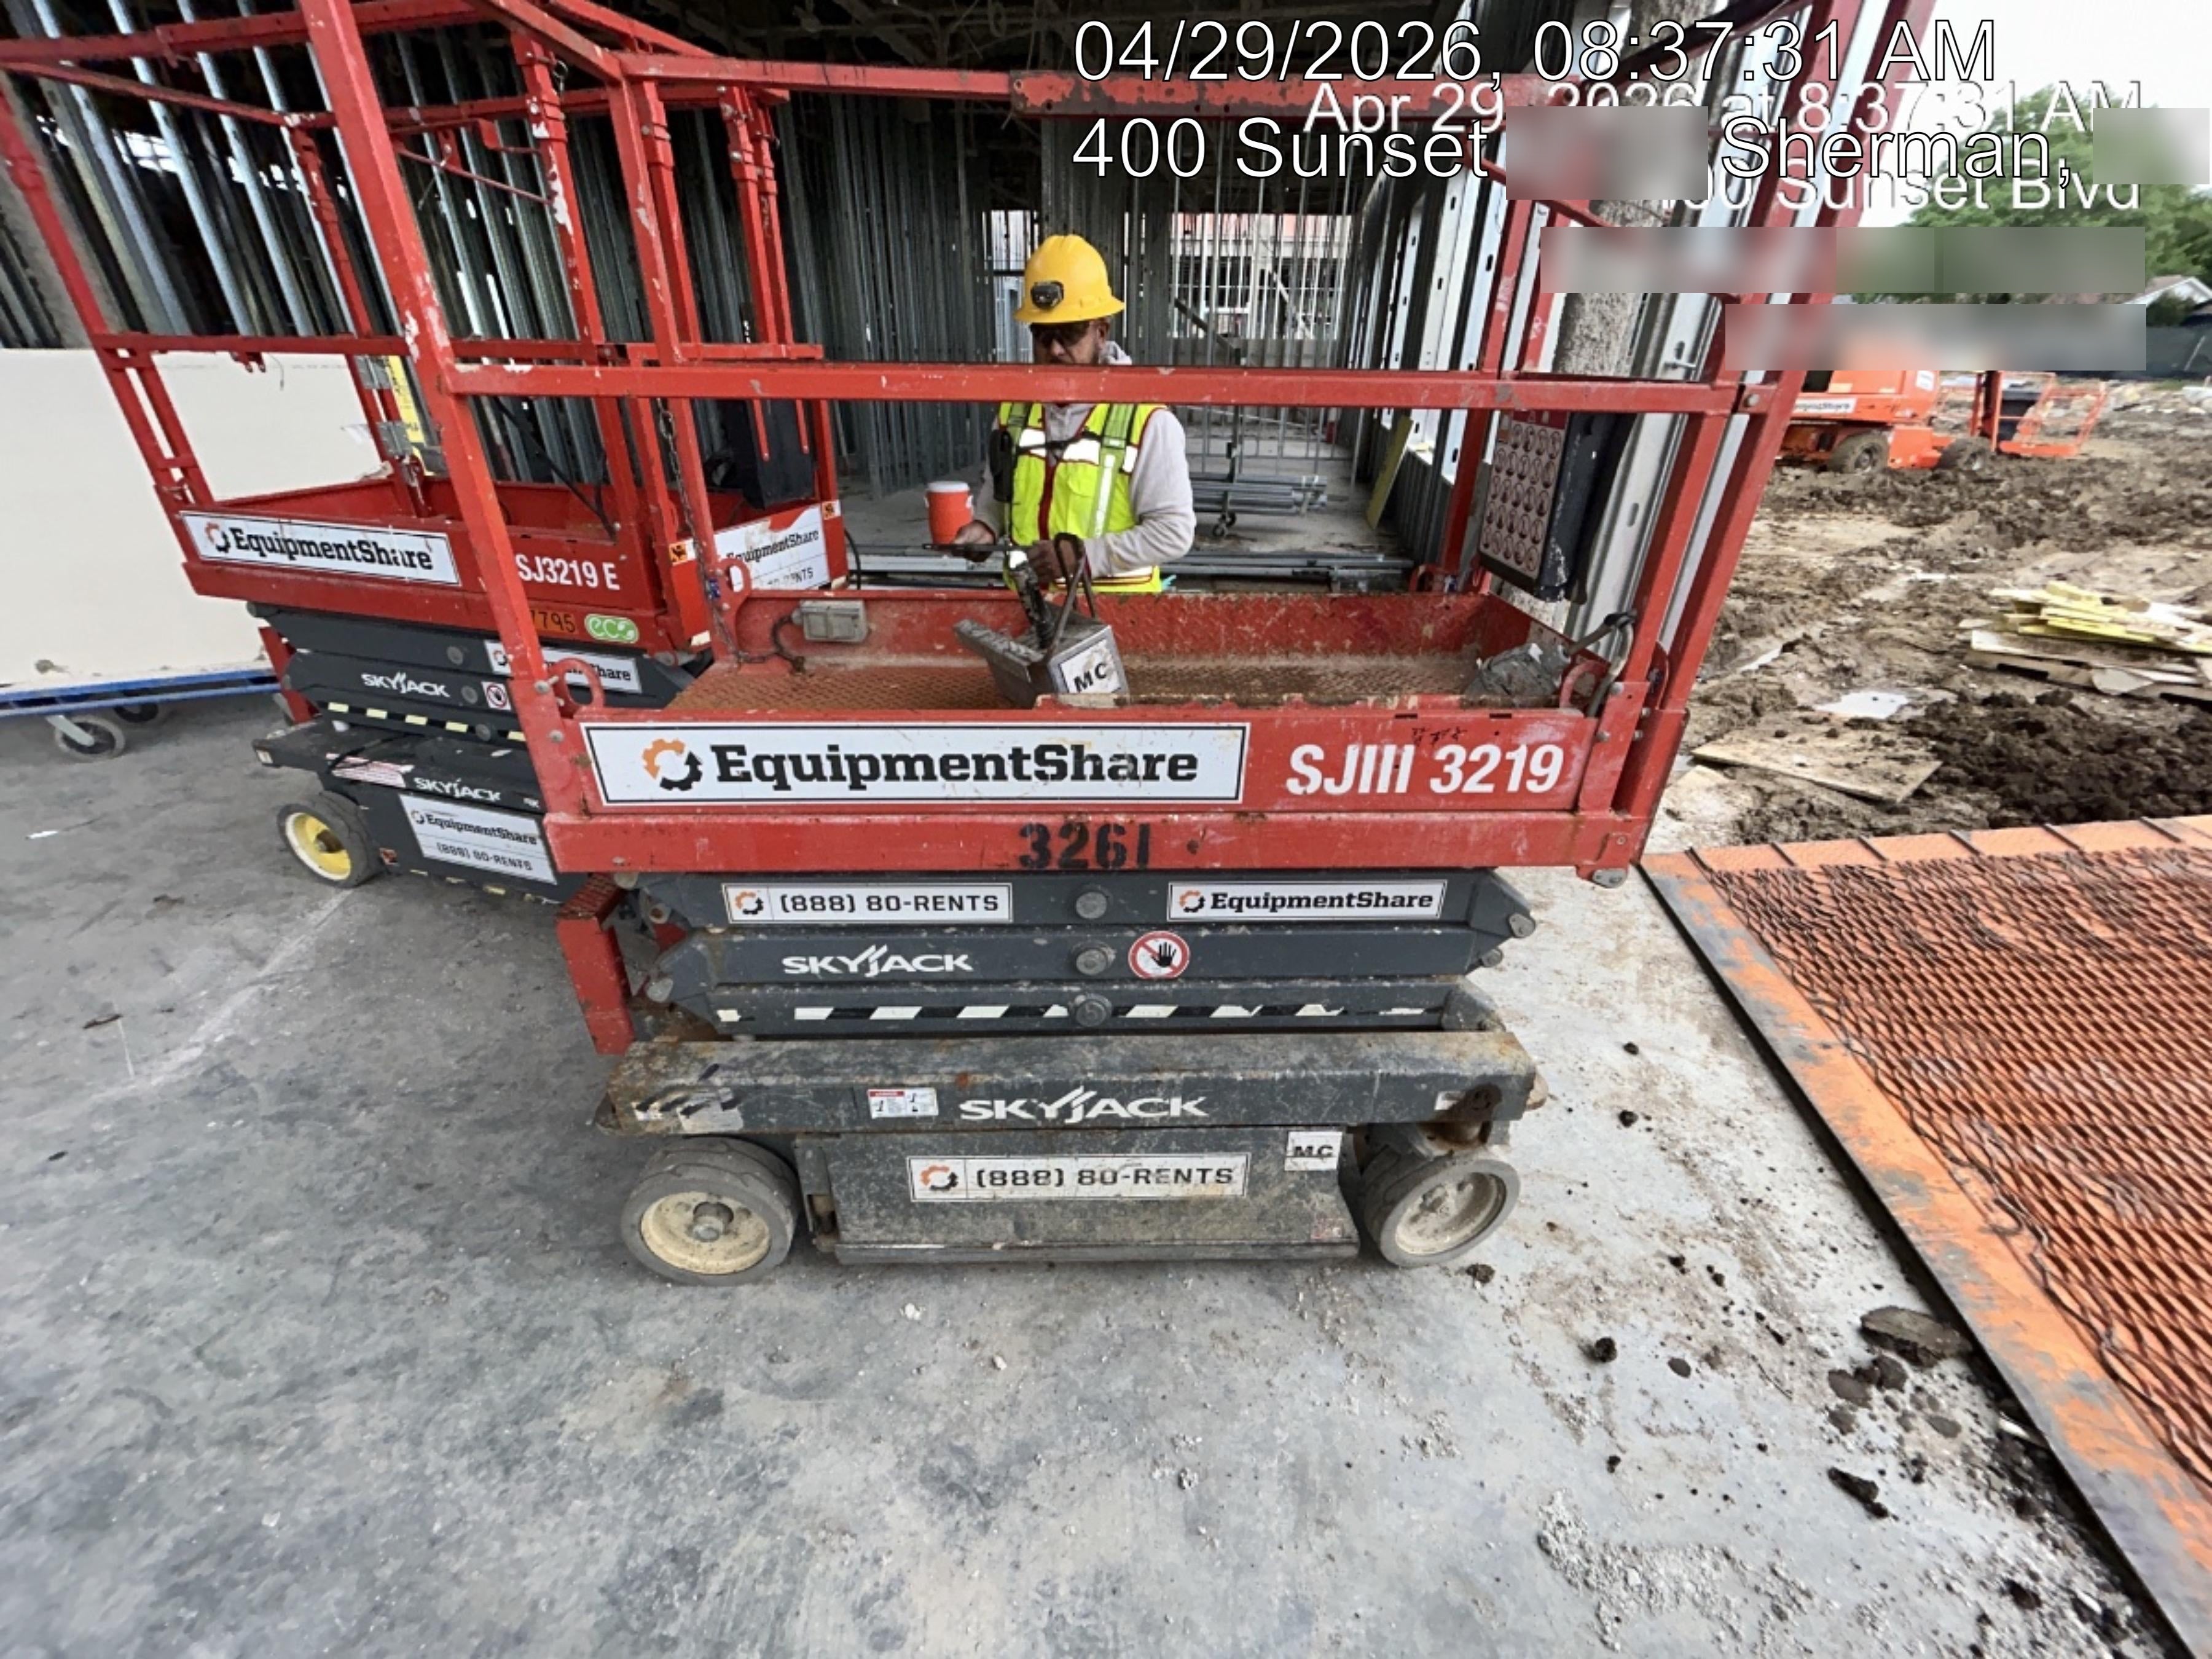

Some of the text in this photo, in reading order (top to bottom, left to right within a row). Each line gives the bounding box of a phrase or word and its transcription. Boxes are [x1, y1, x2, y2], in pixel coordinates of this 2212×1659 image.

[233, 528, 434, 571] EquipmentShare
[515, 554, 621, 590] SJ3219 E
[361, 671, 451, 698] SKYJACK
[1073, 662, 1108, 694] MC
[711, 742, 1198, 791] EquipmentShare
[1286, 744, 1564, 795] SJIII 3219
[413, 777, 501, 802] SKYJACK
[426, 813, 538, 845] EquipmentShare
[1019, 822, 1151, 869] 3261
[780, 893, 999, 914] (888) 80-RENTS
[1210, 890, 1433, 913] EquipmentShare
[782, 944, 973, 978] SKYJACK
[959, 1084, 1210, 1124] SKYJACK
[1293, 1145, 1333, 1157] MC
[976, 1168, 1234, 1188] (888) 80-RENTS
